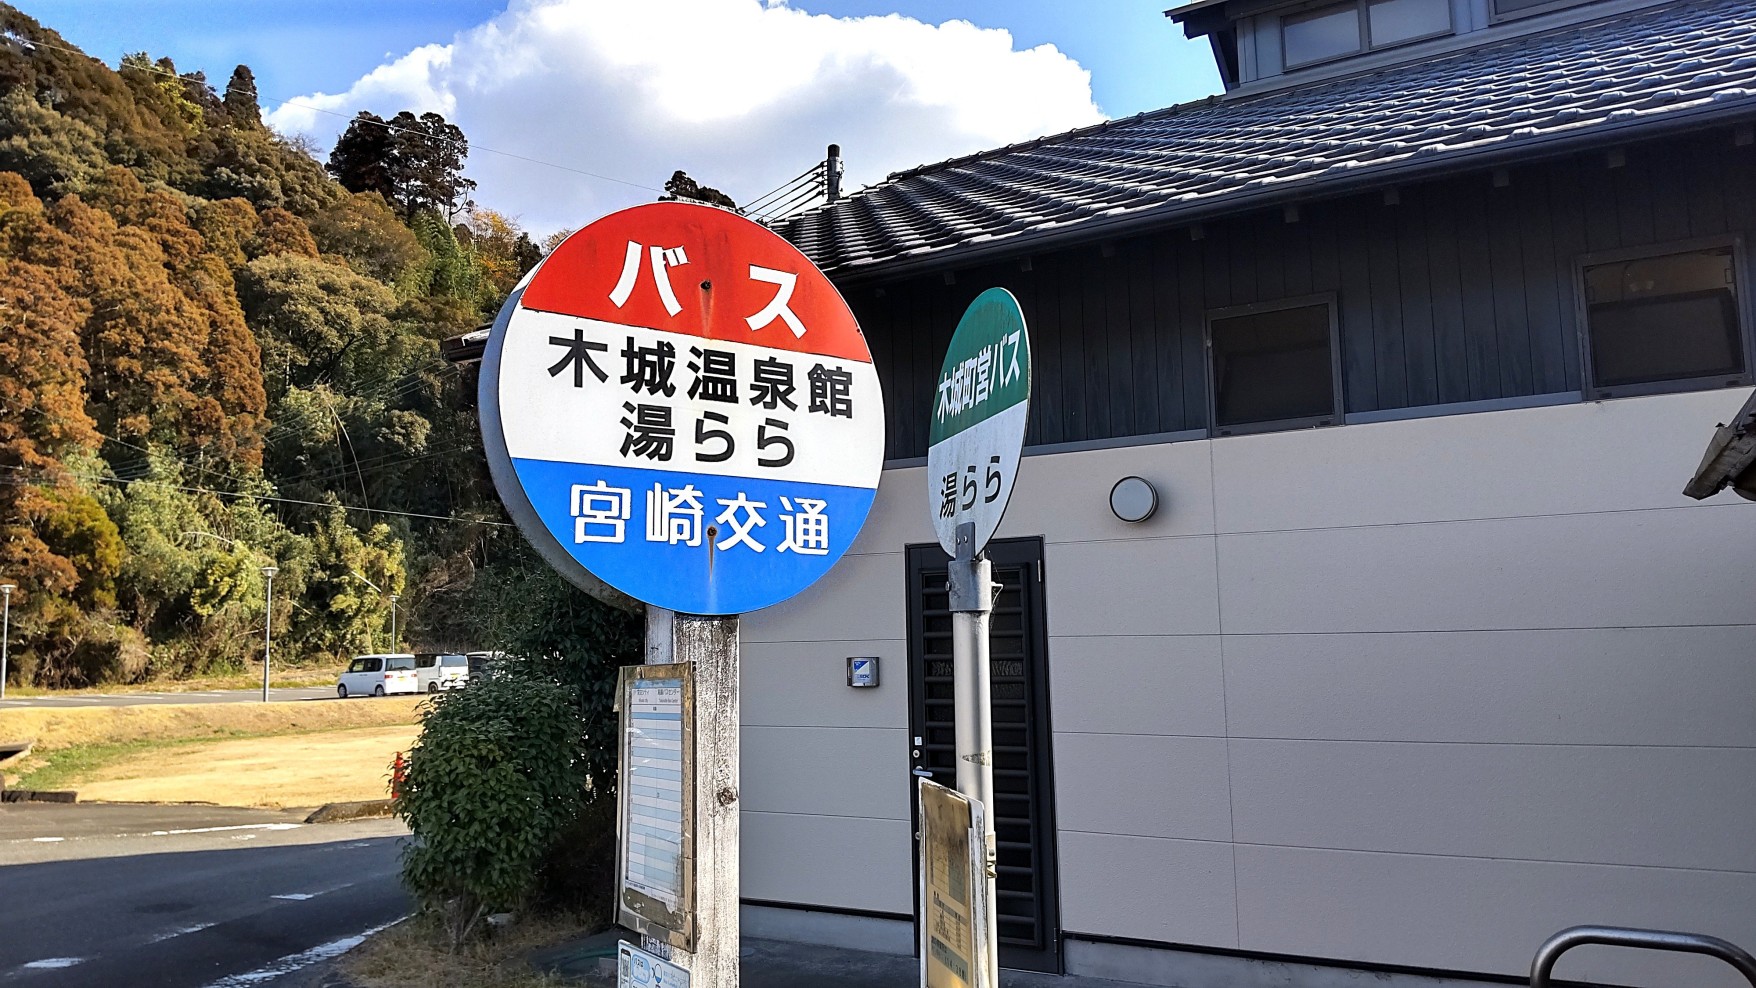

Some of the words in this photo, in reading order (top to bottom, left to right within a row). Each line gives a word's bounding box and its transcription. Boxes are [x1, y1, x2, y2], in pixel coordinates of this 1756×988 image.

[608, 240, 808, 339] バス
[547, 327, 854, 419] 木城温泉館
[936, 328, 1021, 424] 木城町営バス
[618, 400, 797, 468] 湯らら
[569, 480, 831, 556] 宮崎交通
[939, 455, 1002, 520] 湯らら
